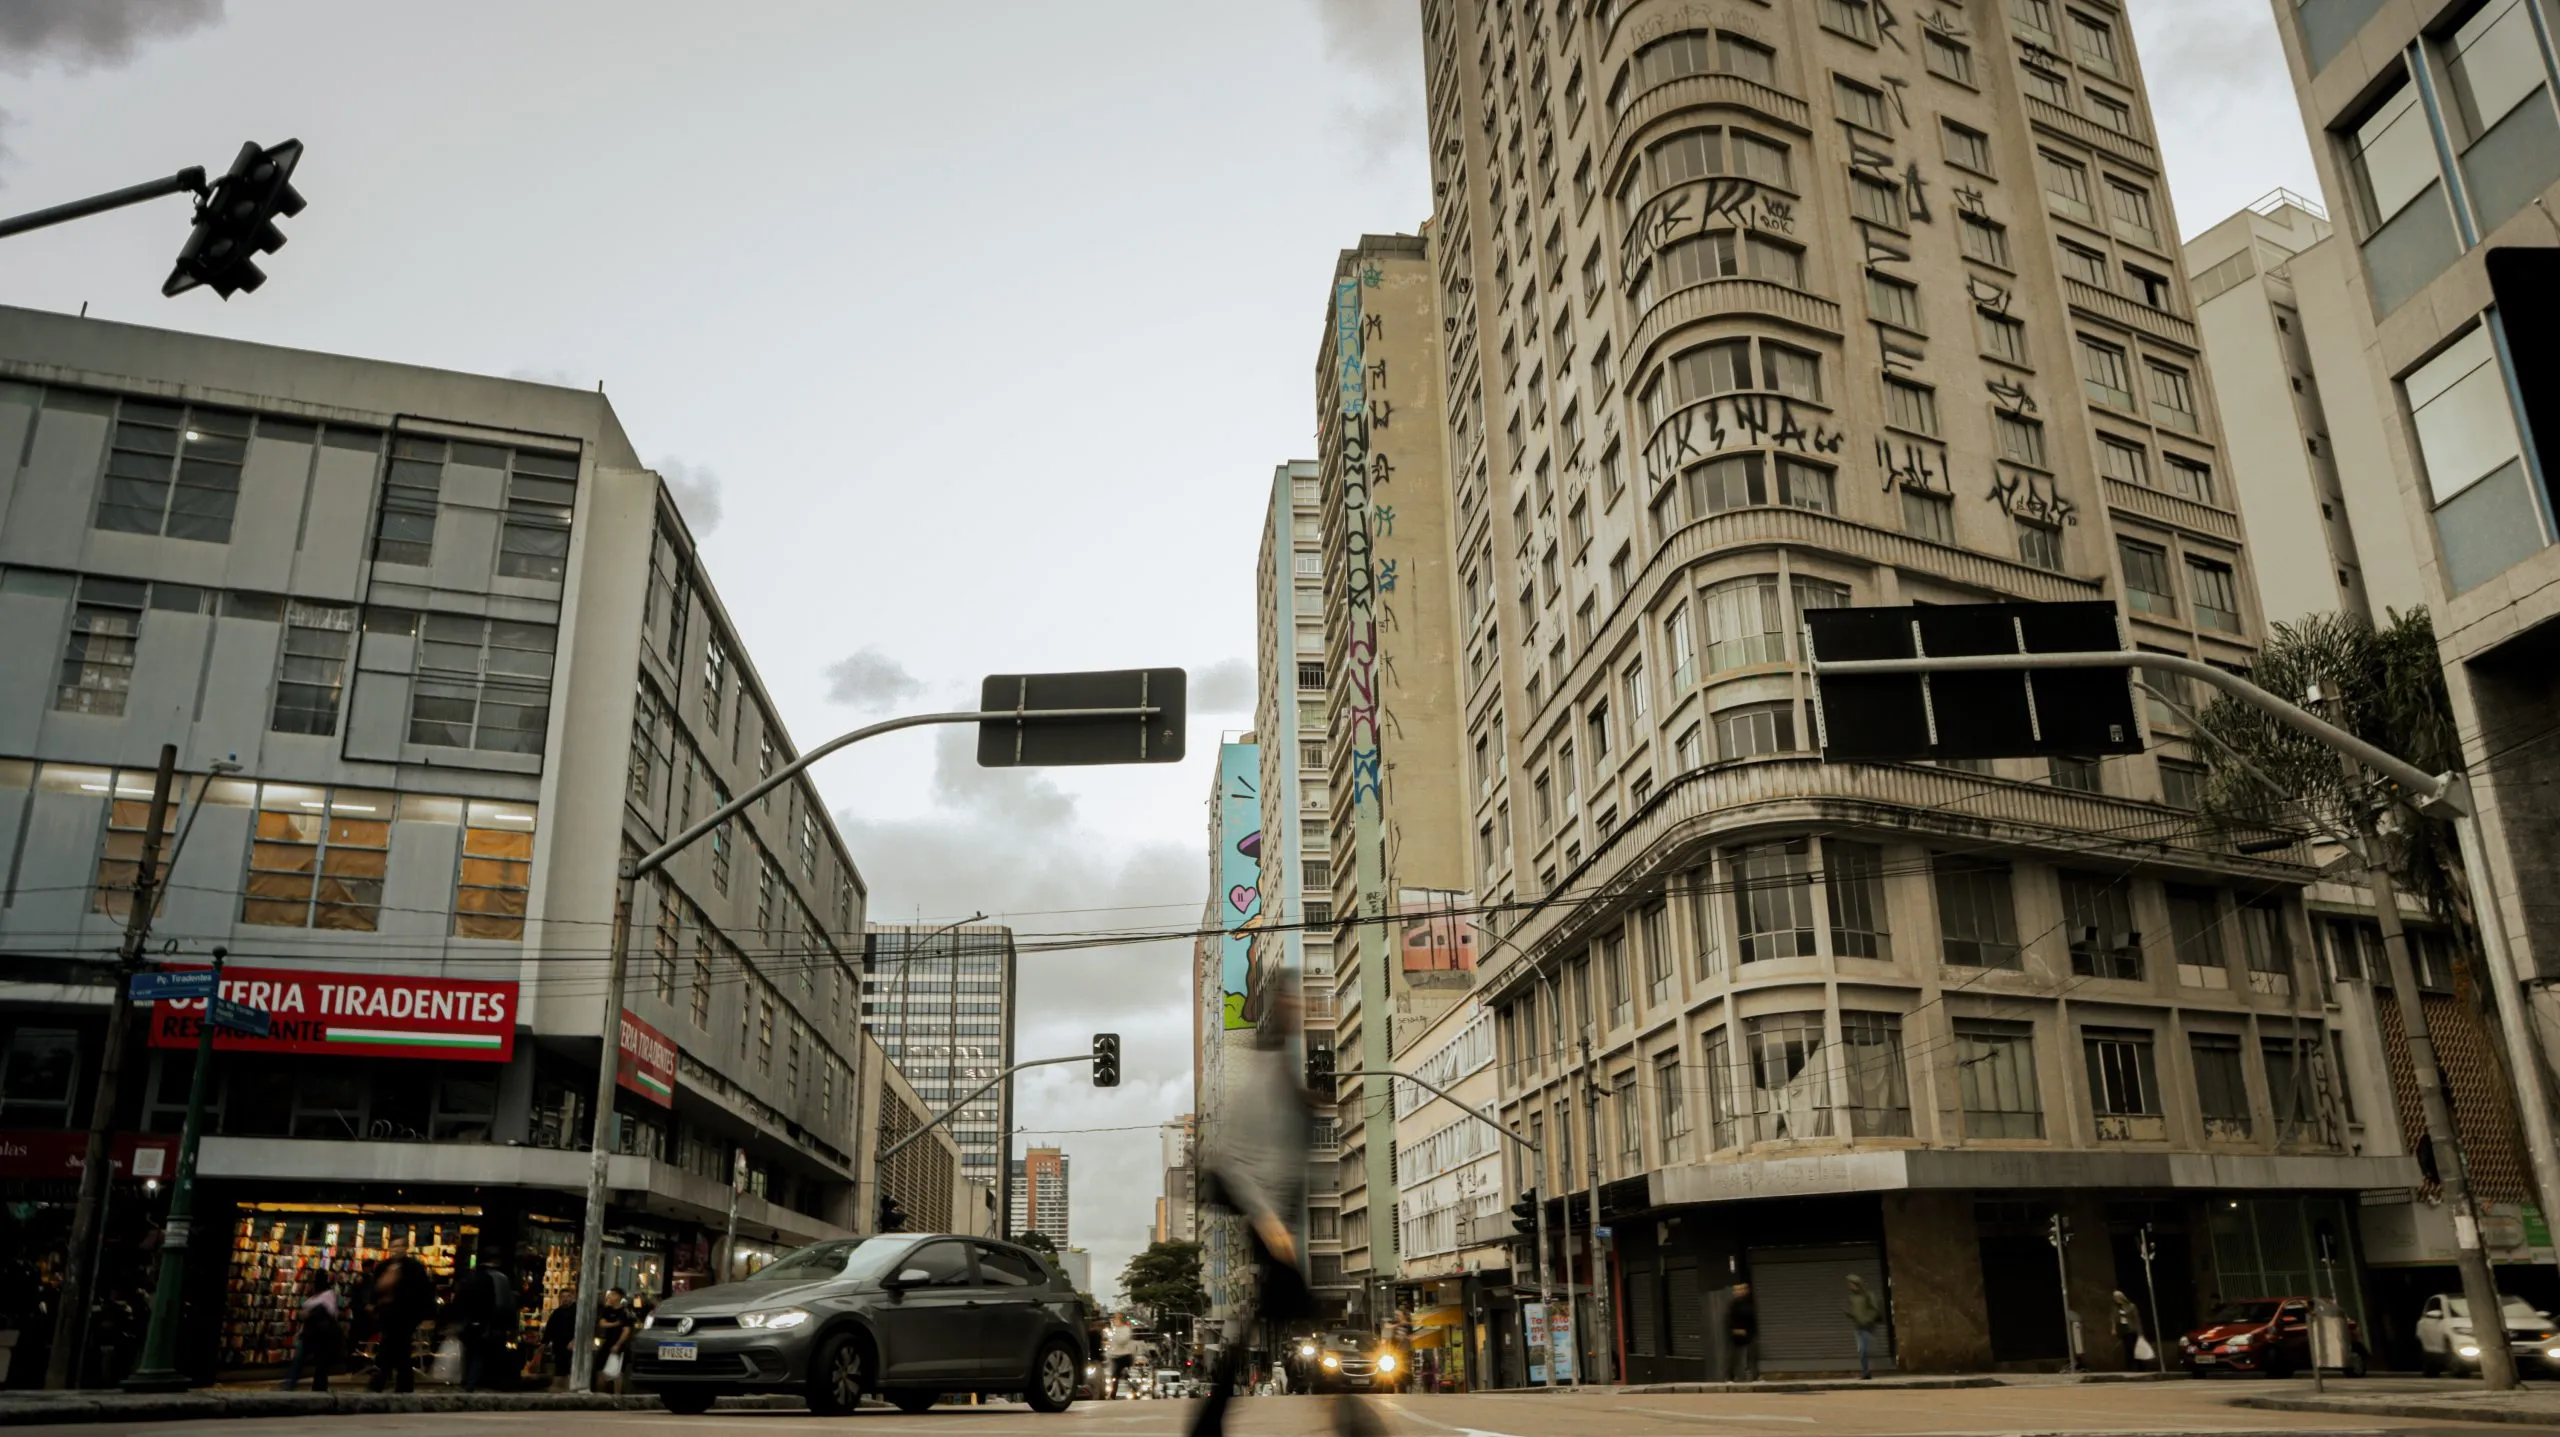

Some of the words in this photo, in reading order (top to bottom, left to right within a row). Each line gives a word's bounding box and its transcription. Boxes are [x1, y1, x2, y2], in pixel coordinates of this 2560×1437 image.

[171, 973, 213, 984] Tiradentes
[318, 984, 506, 1023] TIRADENTES
[638, 1031, 675, 1077] TIRADENTES
